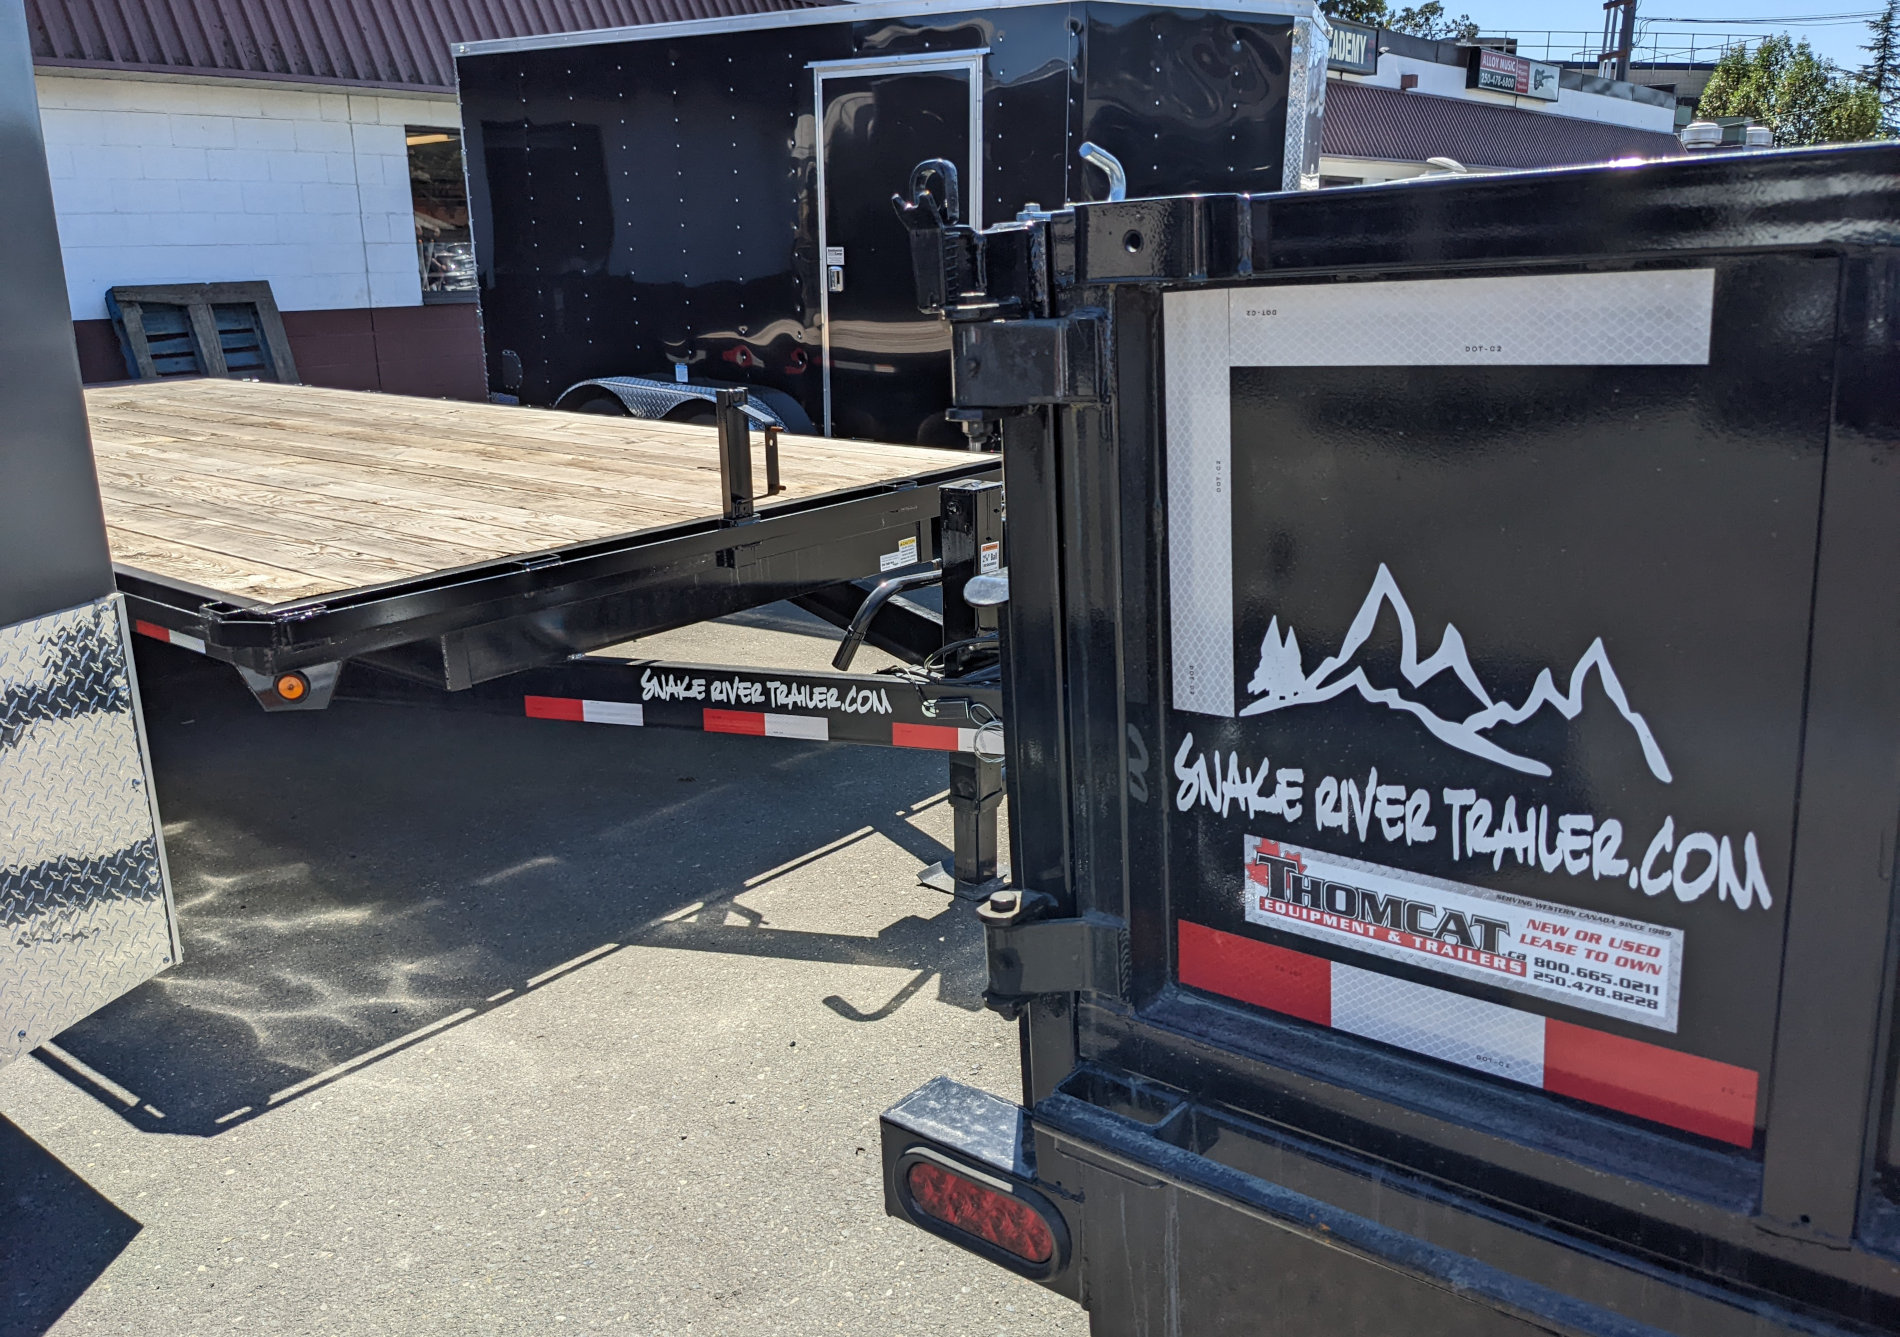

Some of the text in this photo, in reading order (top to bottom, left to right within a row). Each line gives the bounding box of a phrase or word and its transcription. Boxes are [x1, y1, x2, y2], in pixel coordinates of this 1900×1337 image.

[1482, 54, 1516, 72] ALLOY MUSIC
[640, 668, 892, 714] SNAKE RIVER TRAILER.COM
[1174, 732, 1772, 910] SNAKE RIVER TRAILER.COM
[1262, 898, 1522, 973] EQUIPMENT & TRAILERS
[1496, 894, 1673, 938] SERVING WESTERN CANADA SINCE 1989
[1519, 933, 1663, 976] LEASE TO OWN
[1526, 918, 1661, 959] NEW OR USED
[1533, 970, 1659, 1010] 250.478.8228
[1534, 956, 1659, 997] 800.665.0211
